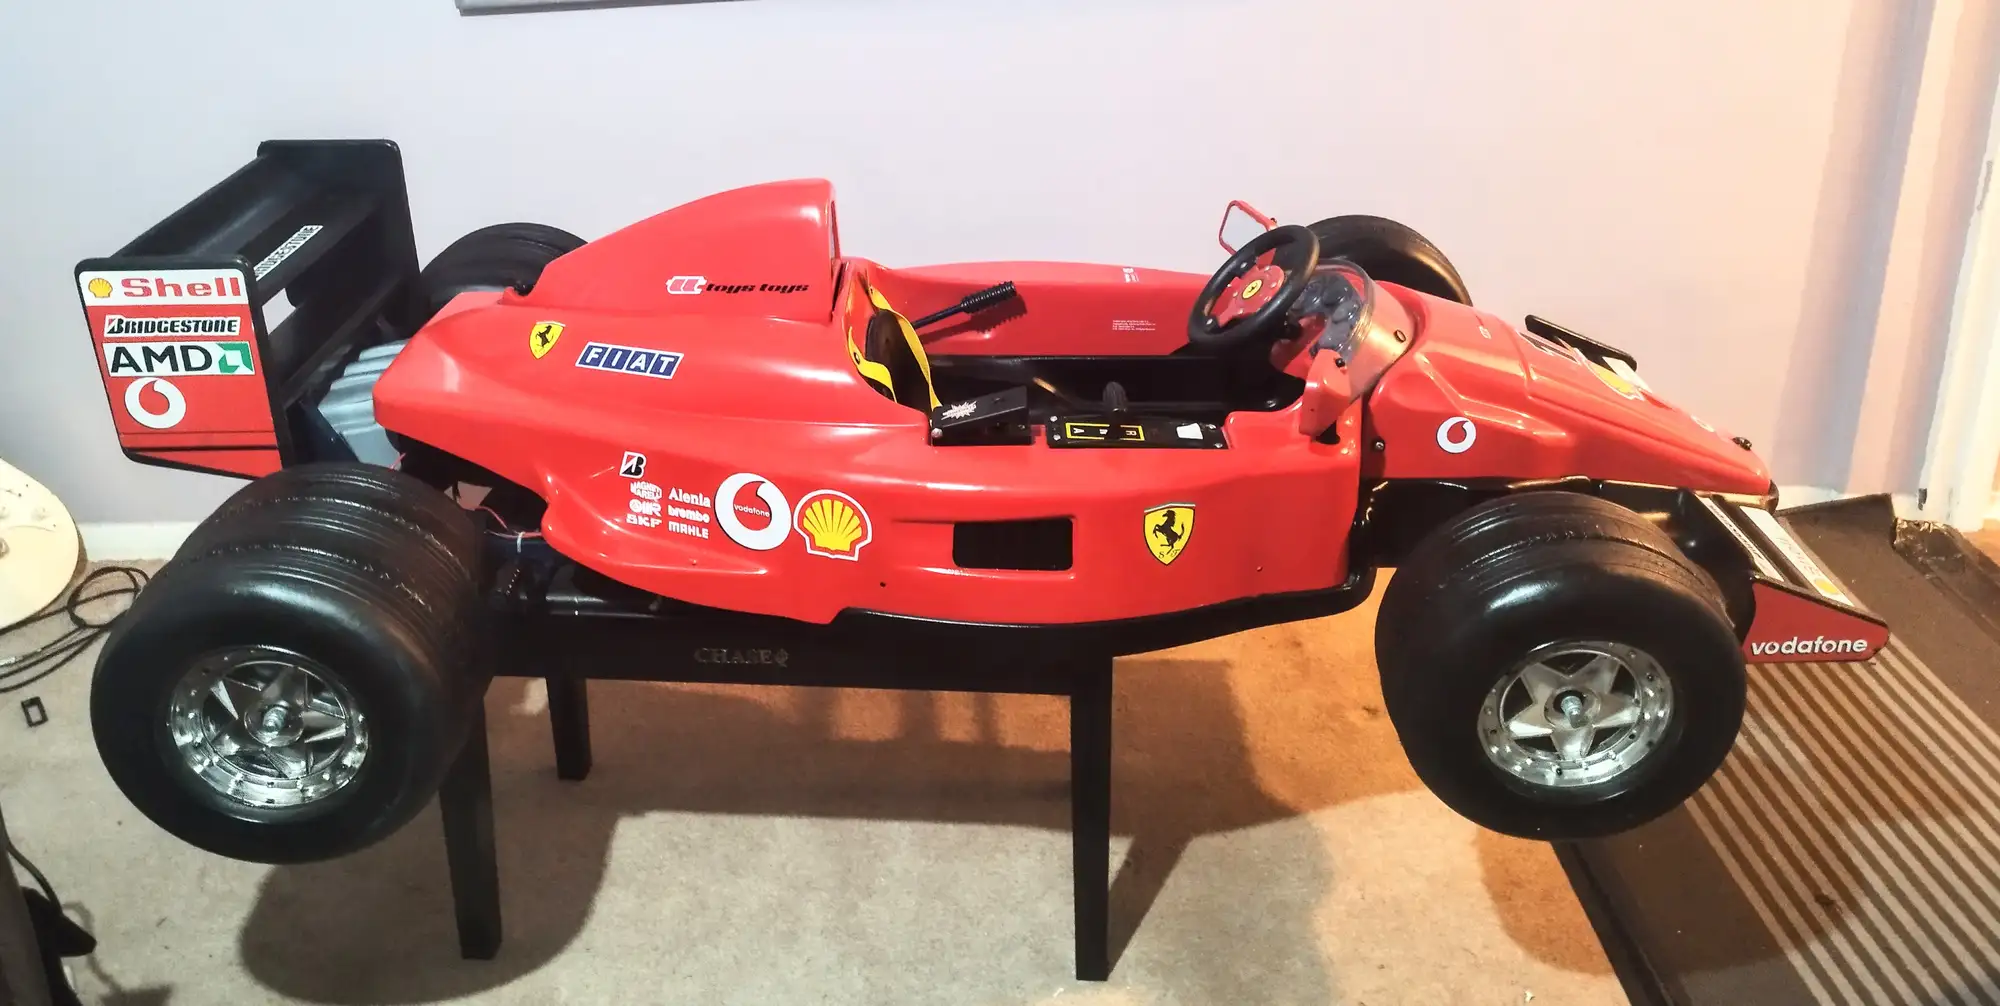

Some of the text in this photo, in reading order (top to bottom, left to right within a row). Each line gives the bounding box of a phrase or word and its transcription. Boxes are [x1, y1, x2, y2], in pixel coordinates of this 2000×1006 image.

[121, 277, 242, 297] Shell
[706, 283, 809, 293] toys toys
[107, 317, 238, 334] BRIDGESTONE
[111, 345, 213, 373] AMD
[584, 346, 678, 374] FIAT
[668, 487, 711, 508] Alenia
[667, 504, 710, 523] brembo
[733, 503, 770, 518] vodafone
[626, 513, 662, 528] SKF
[668, 520, 709, 539] MAHLE
[1751, 635, 1868, 655] vodafone
